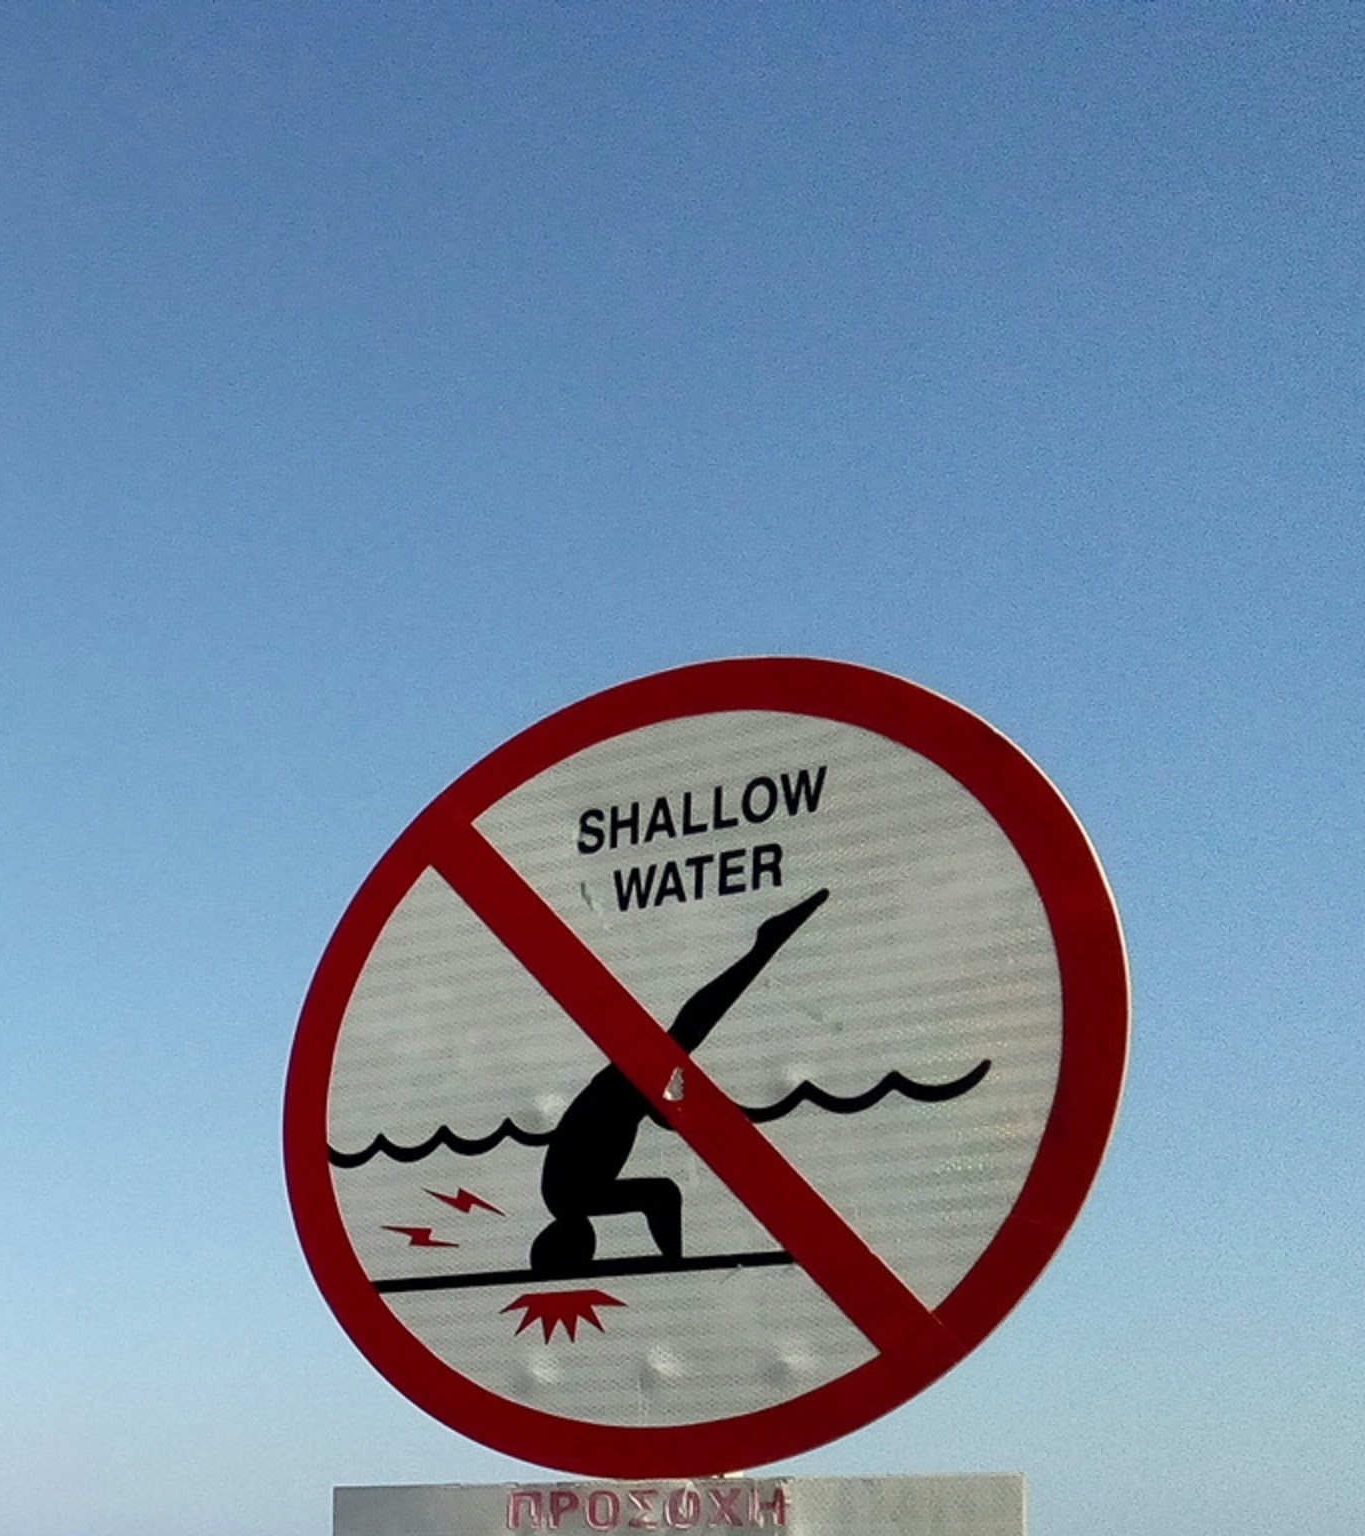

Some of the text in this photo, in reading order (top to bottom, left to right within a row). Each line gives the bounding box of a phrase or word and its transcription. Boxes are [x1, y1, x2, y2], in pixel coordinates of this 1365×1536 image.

[577, 765, 828, 855] SHALLOW
[613, 842, 784, 912] WATER
[506, 1486, 788, 1531] ΠΡΟΣΟΧΗ
